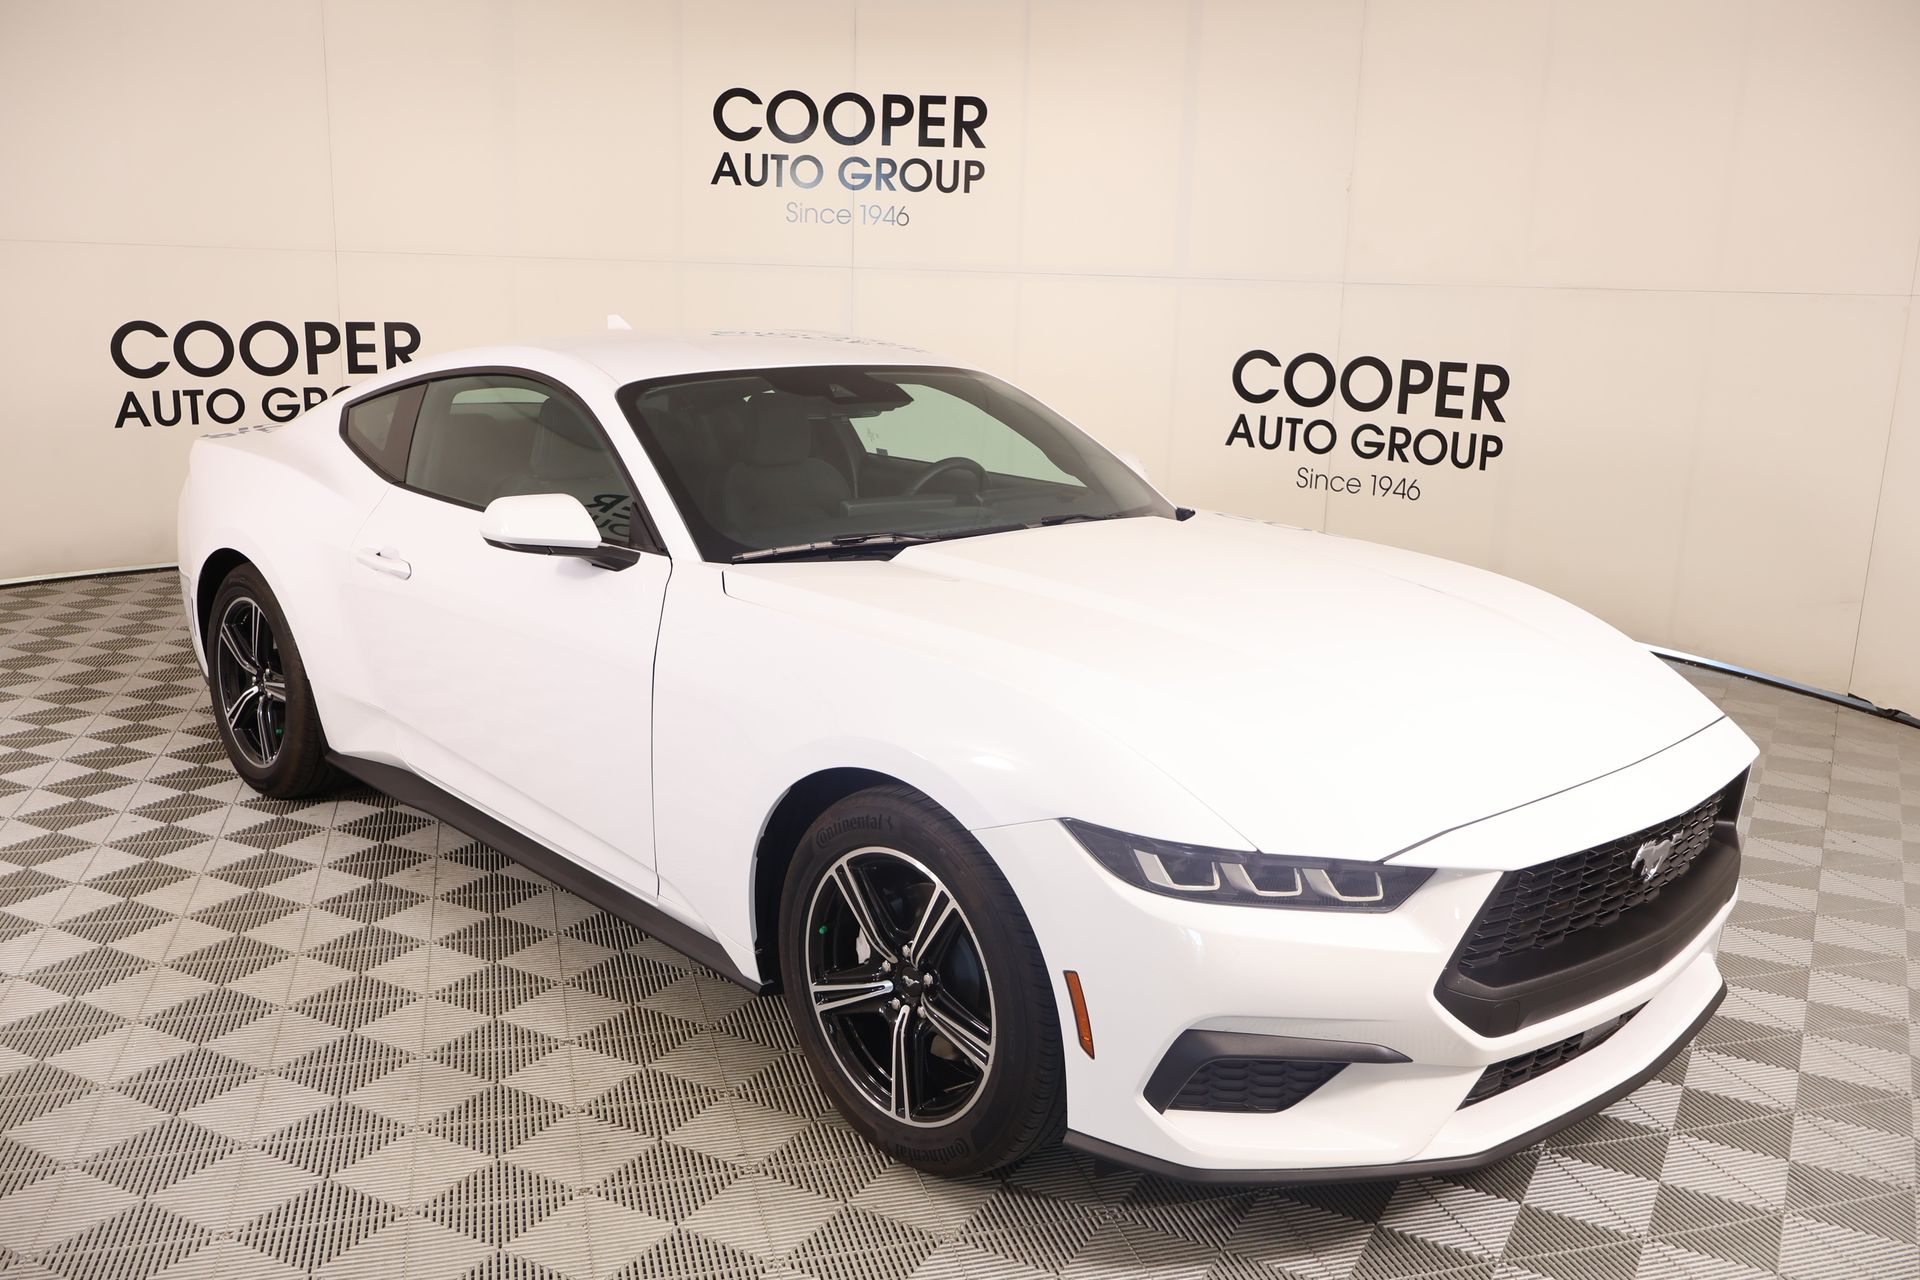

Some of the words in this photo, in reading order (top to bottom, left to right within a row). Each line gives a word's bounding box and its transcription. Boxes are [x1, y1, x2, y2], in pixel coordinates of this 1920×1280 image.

[713, 87, 988, 148] COOPER
[710, 151, 824, 189] AUTO
[838, 156, 985, 193] GROUP
[785, 201, 851, 224] Since
[860, 204, 910, 226] 1946
[110, 320, 421, 379] COOPER
[114, 387, 246, 428] AUTO
[261, 385, 352, 423] GR
[1232, 349, 1510, 423] COOPER
[1225, 413, 1337, 455] AUTO
[1351, 423, 1503, 471] GROUP
[1296, 467, 1361, 494] Since
[1371, 474, 1421, 501] 1946
[815, 813, 884, 849] Continental
